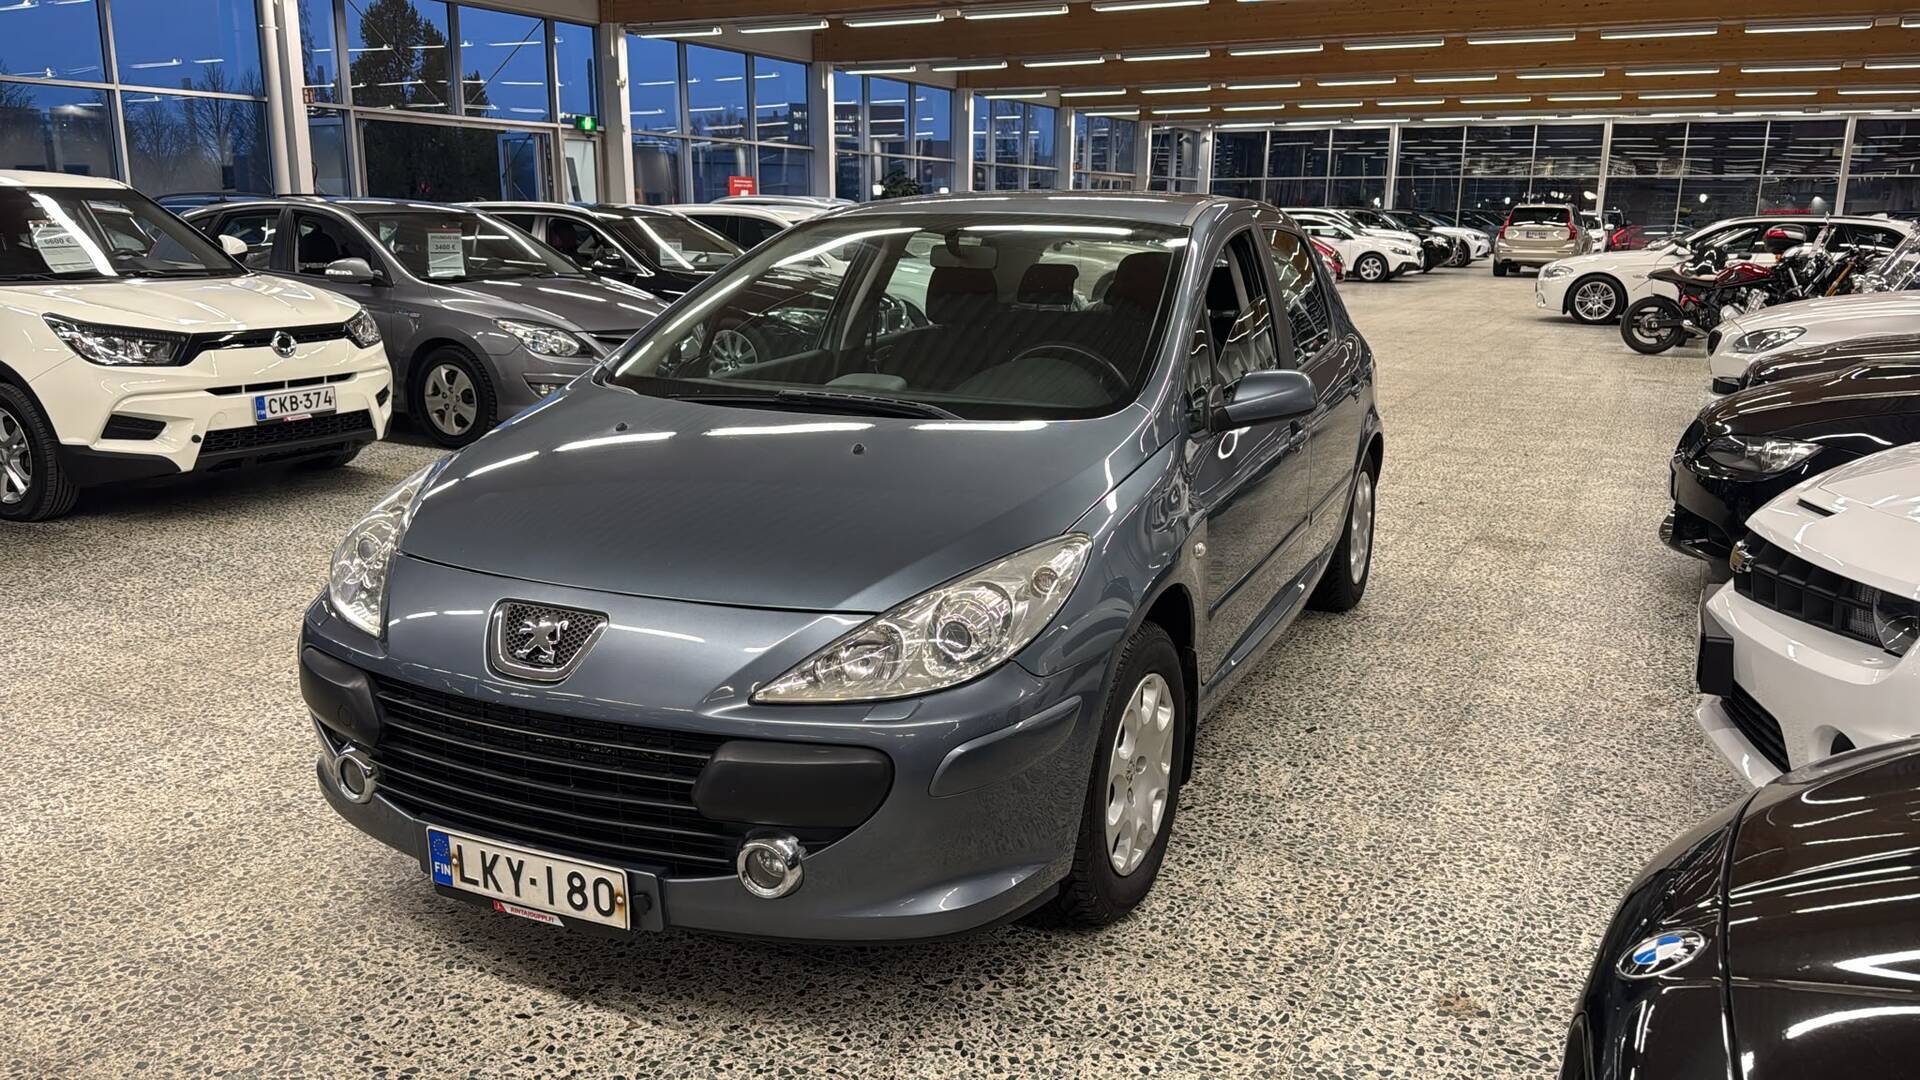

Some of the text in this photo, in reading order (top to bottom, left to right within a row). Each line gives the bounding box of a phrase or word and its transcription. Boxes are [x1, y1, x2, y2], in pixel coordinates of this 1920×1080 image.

[65, 236, 73, 244] €
[268, 390, 333, 415] CKB-374
[434, 844, 617, 918] FIN LKY-180
